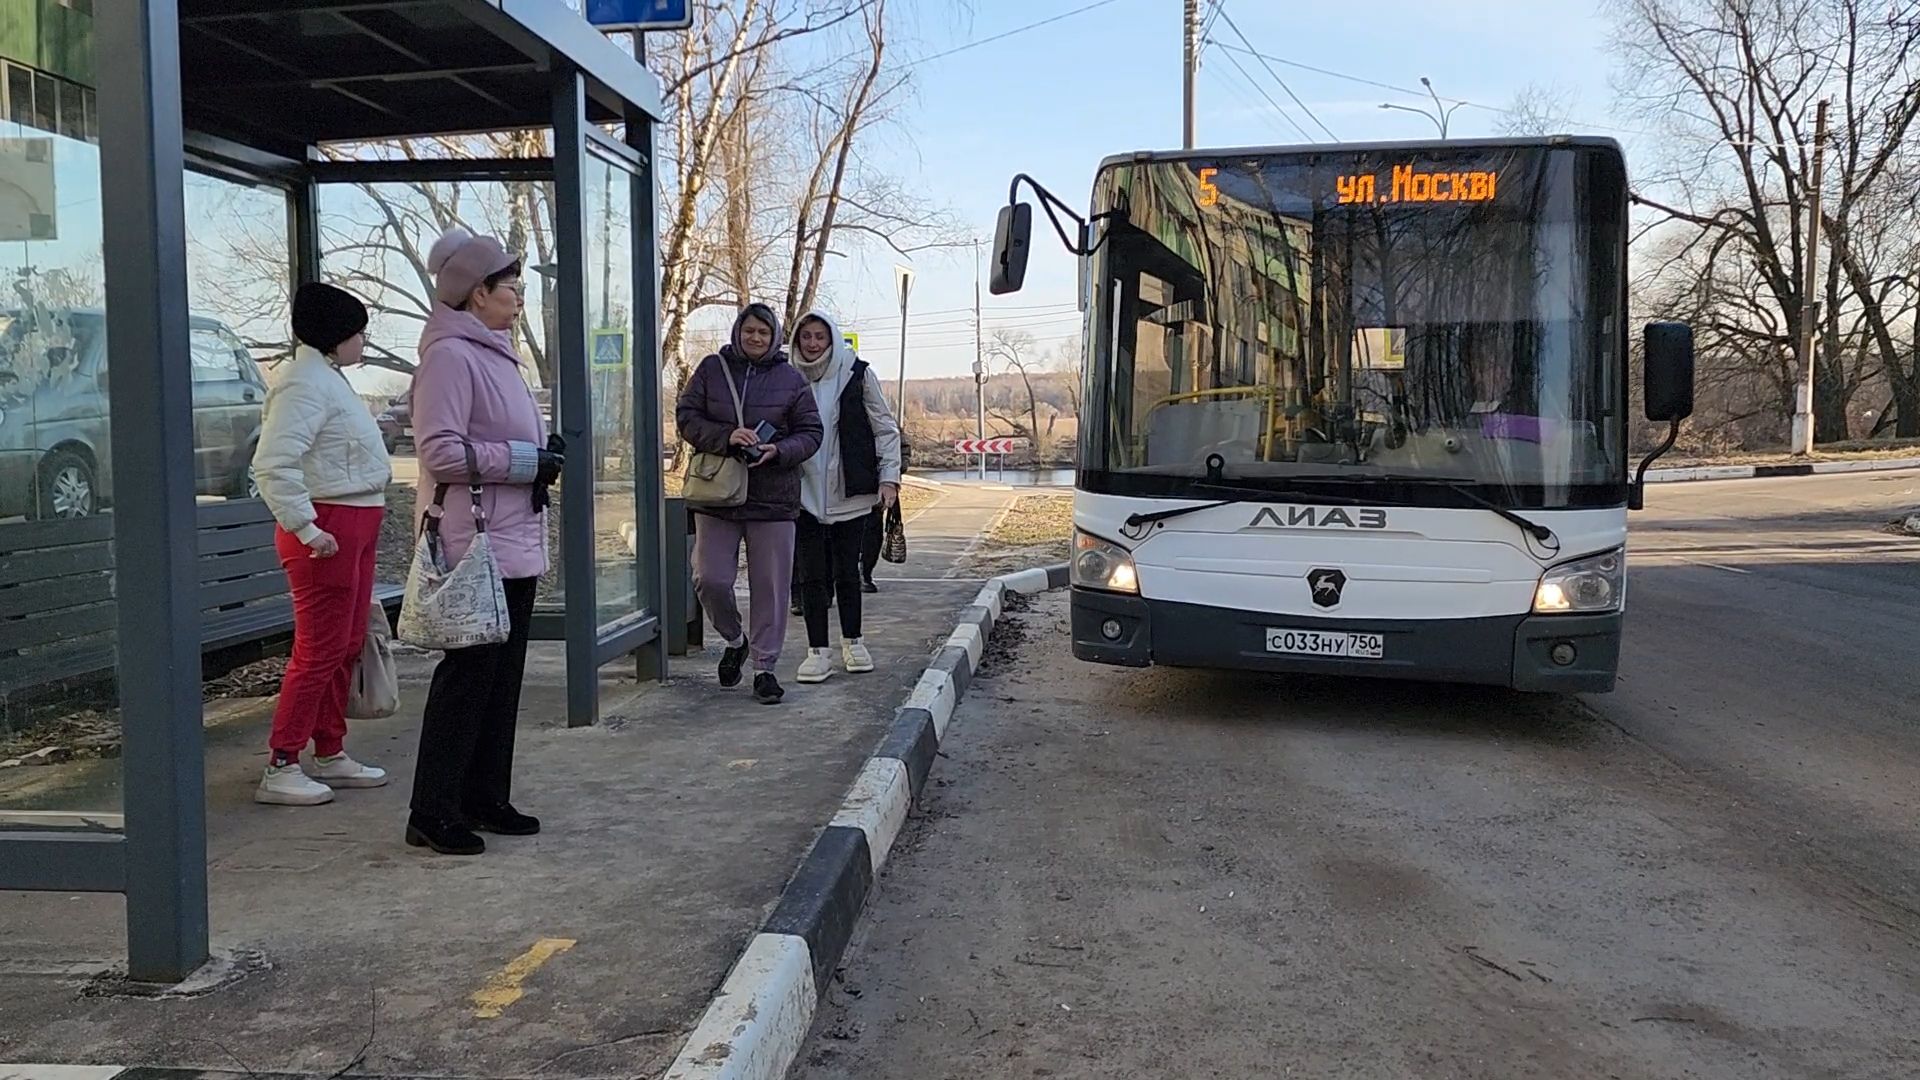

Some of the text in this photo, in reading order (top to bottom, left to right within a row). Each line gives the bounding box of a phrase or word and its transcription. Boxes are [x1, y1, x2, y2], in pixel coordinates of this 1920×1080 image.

[1200, 168, 1217, 205] 5
[1249, 506, 1387, 528] ЛИАЗ
[1349, 635, 1378, 650] 750
